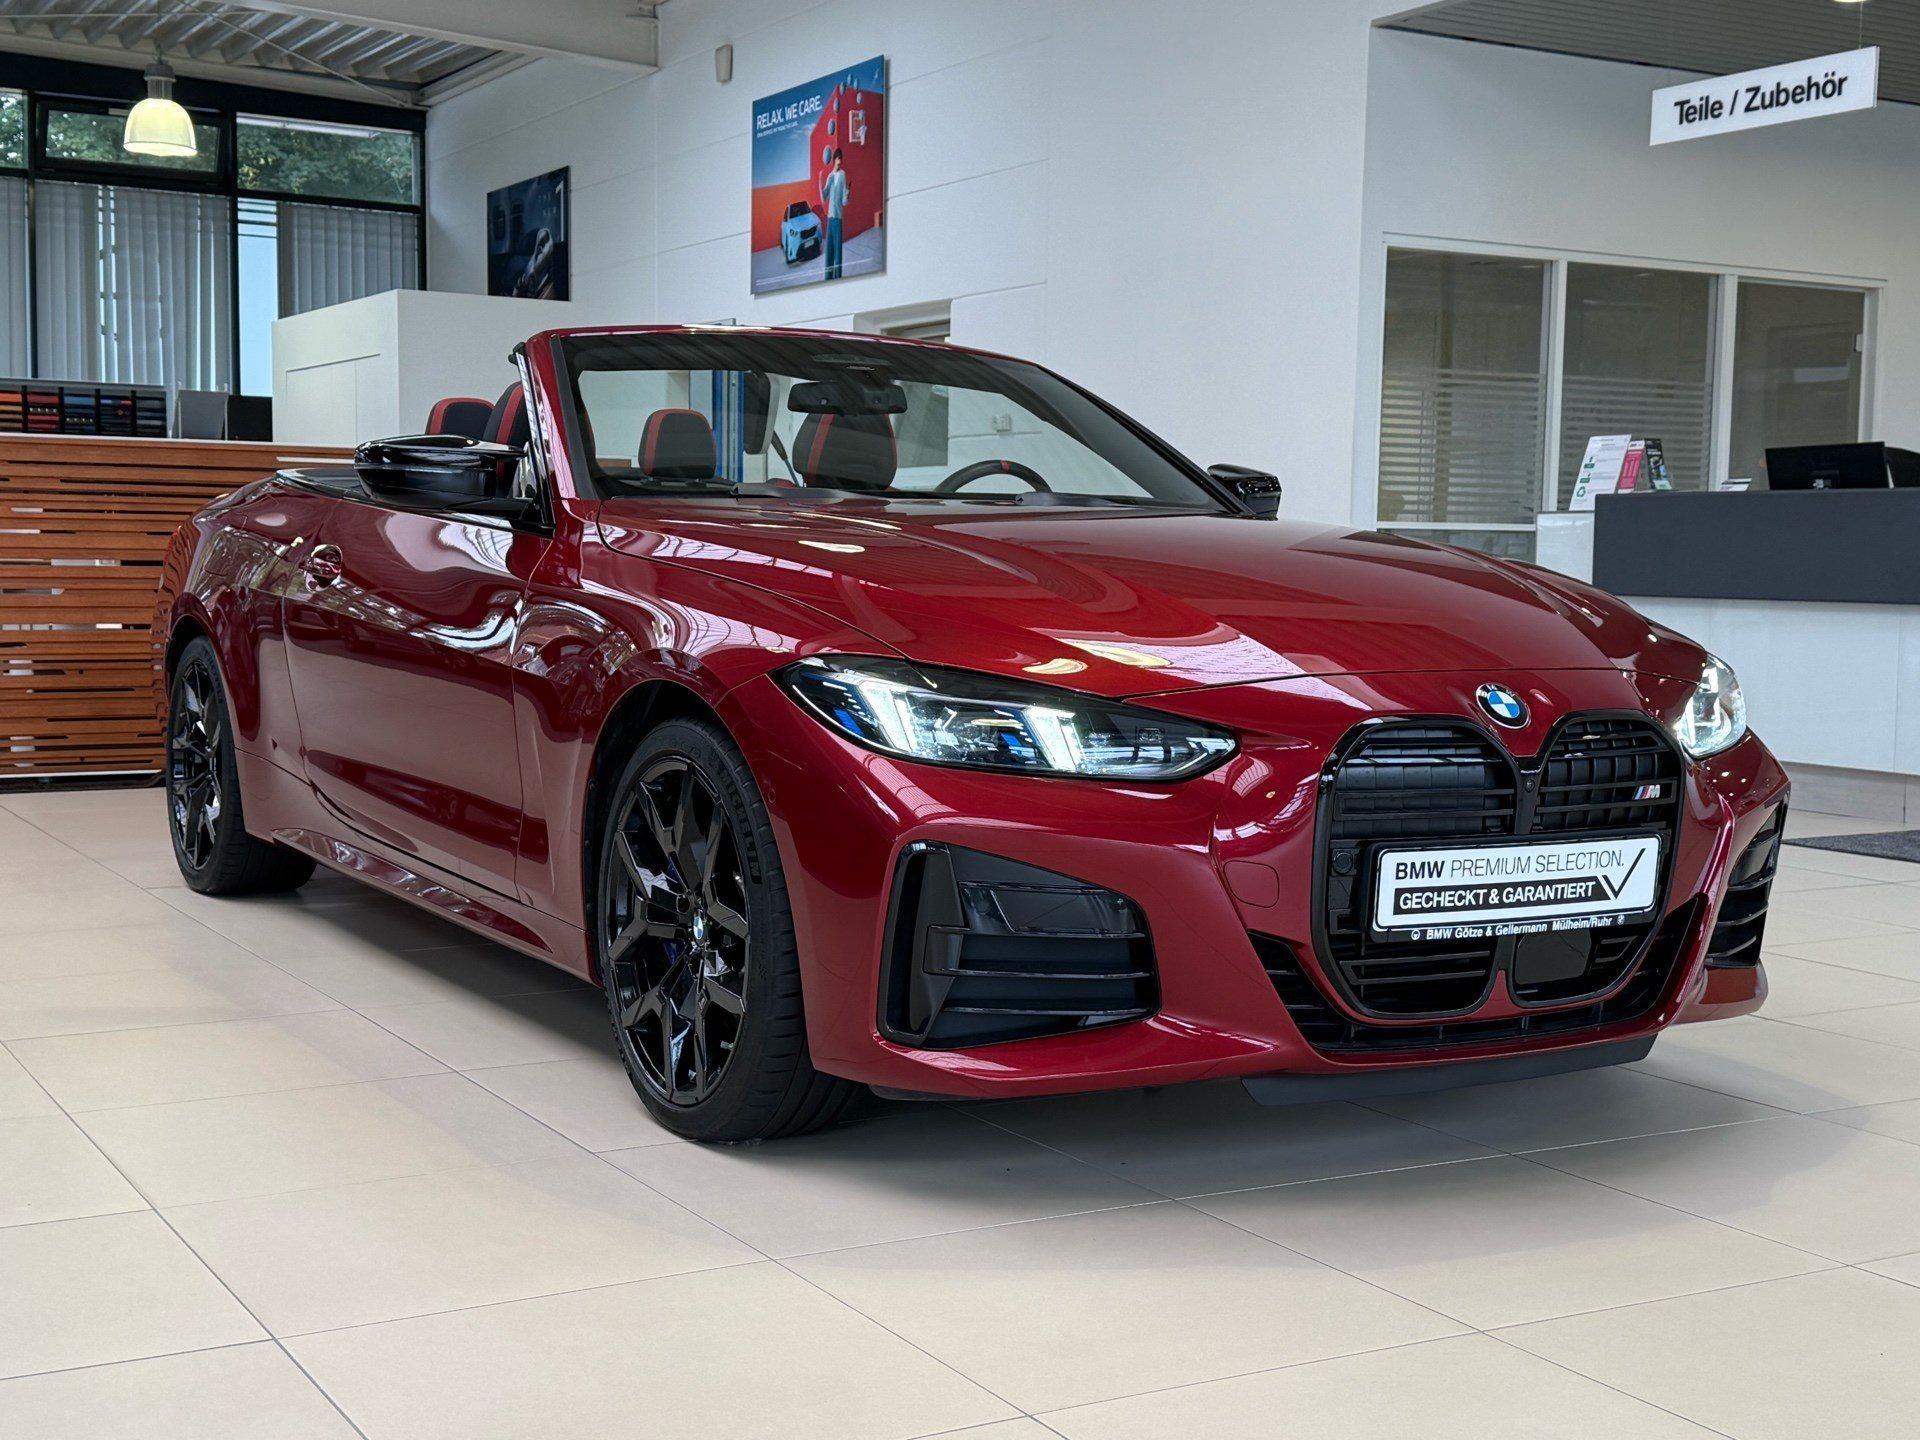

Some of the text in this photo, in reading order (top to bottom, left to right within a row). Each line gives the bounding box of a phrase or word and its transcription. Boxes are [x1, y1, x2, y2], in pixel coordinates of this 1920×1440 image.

[784, 103, 798, 120] WE
[1674, 71, 1848, 125] Teile / Zubehör
[555, 180, 564, 242] 1
[1395, 849, 1625, 880] BMW PREMIUM SELECTION.
[1400, 881, 1596, 909] GECHECKT & GARANTIERT
[1426, 928, 1453, 940] BMW
[1455, 927, 1483, 939] Götze
[1485, 925, 1492, 937] &
[1552, 916, 1612, 931] Mülheim/Ruhr
